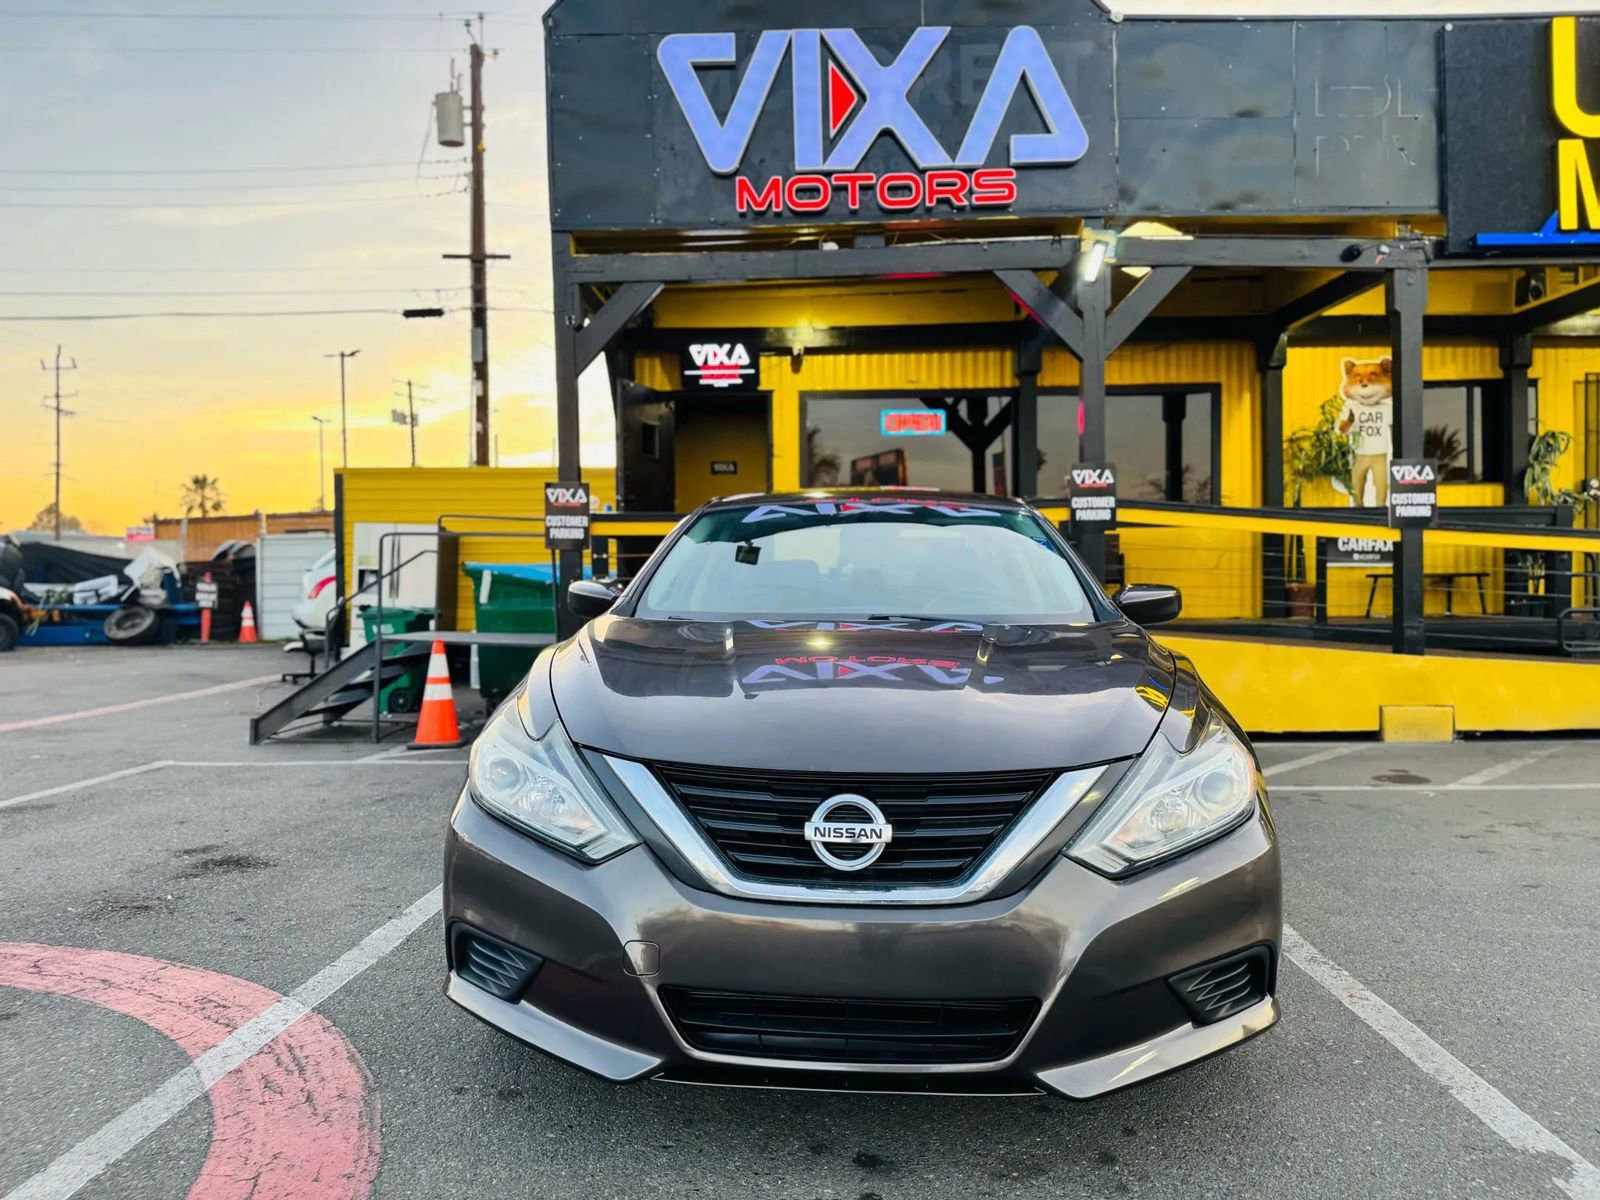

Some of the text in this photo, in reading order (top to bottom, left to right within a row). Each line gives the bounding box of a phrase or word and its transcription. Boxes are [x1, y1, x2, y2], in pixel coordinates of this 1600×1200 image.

[657, 25, 1089, 174] VIXA
[735, 168, 1017, 213] MOTORS
[689, 343, 750, 366] VIXA
[1359, 412, 1383, 423] CAR
[1359, 425, 1382, 437] FOX
[1071, 468, 1114, 484] VIXA
[1391, 464, 1435, 480] VIXA
[546, 488, 588, 503] VIXA
[1391, 493, 1436, 505] CUSTOMER
[1071, 497, 1116, 509] CUSTOMER
[1075, 509, 1111, 521] PARKING
[1395, 505, 1431, 517] PARKING
[546, 515, 589, 527] CUSTOMER
[549, 527, 585, 540] PARKING
[1337, 536, 1394, 552] CARFAX
[814, 826, 882, 839] NISSAN
